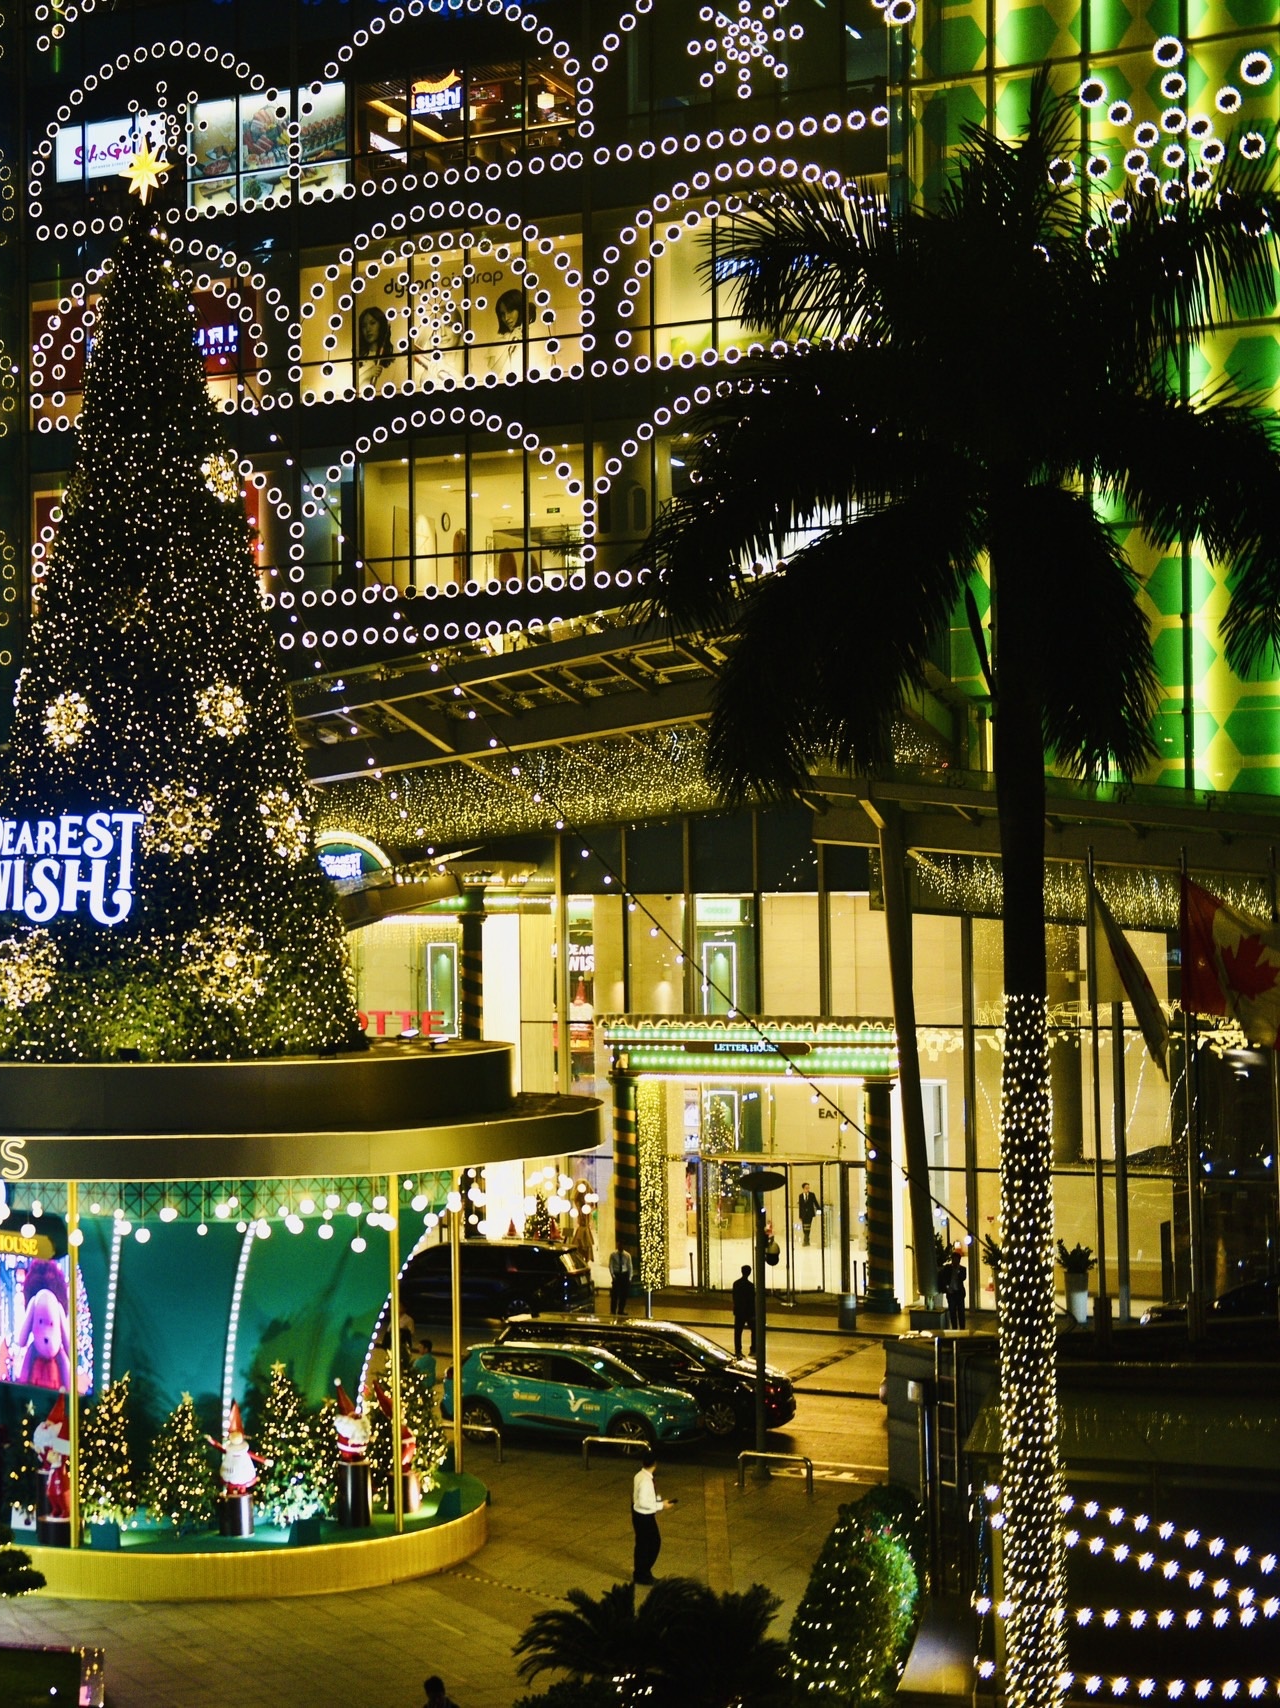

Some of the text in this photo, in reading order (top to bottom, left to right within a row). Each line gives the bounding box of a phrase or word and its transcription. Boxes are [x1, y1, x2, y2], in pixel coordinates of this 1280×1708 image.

[383, 278, 436, 299] dyon
[202, 344, 237, 356] HOTPO
[357, 1010, 444, 1036] TTE
[714, 1043, 749, 1053] LETTER
